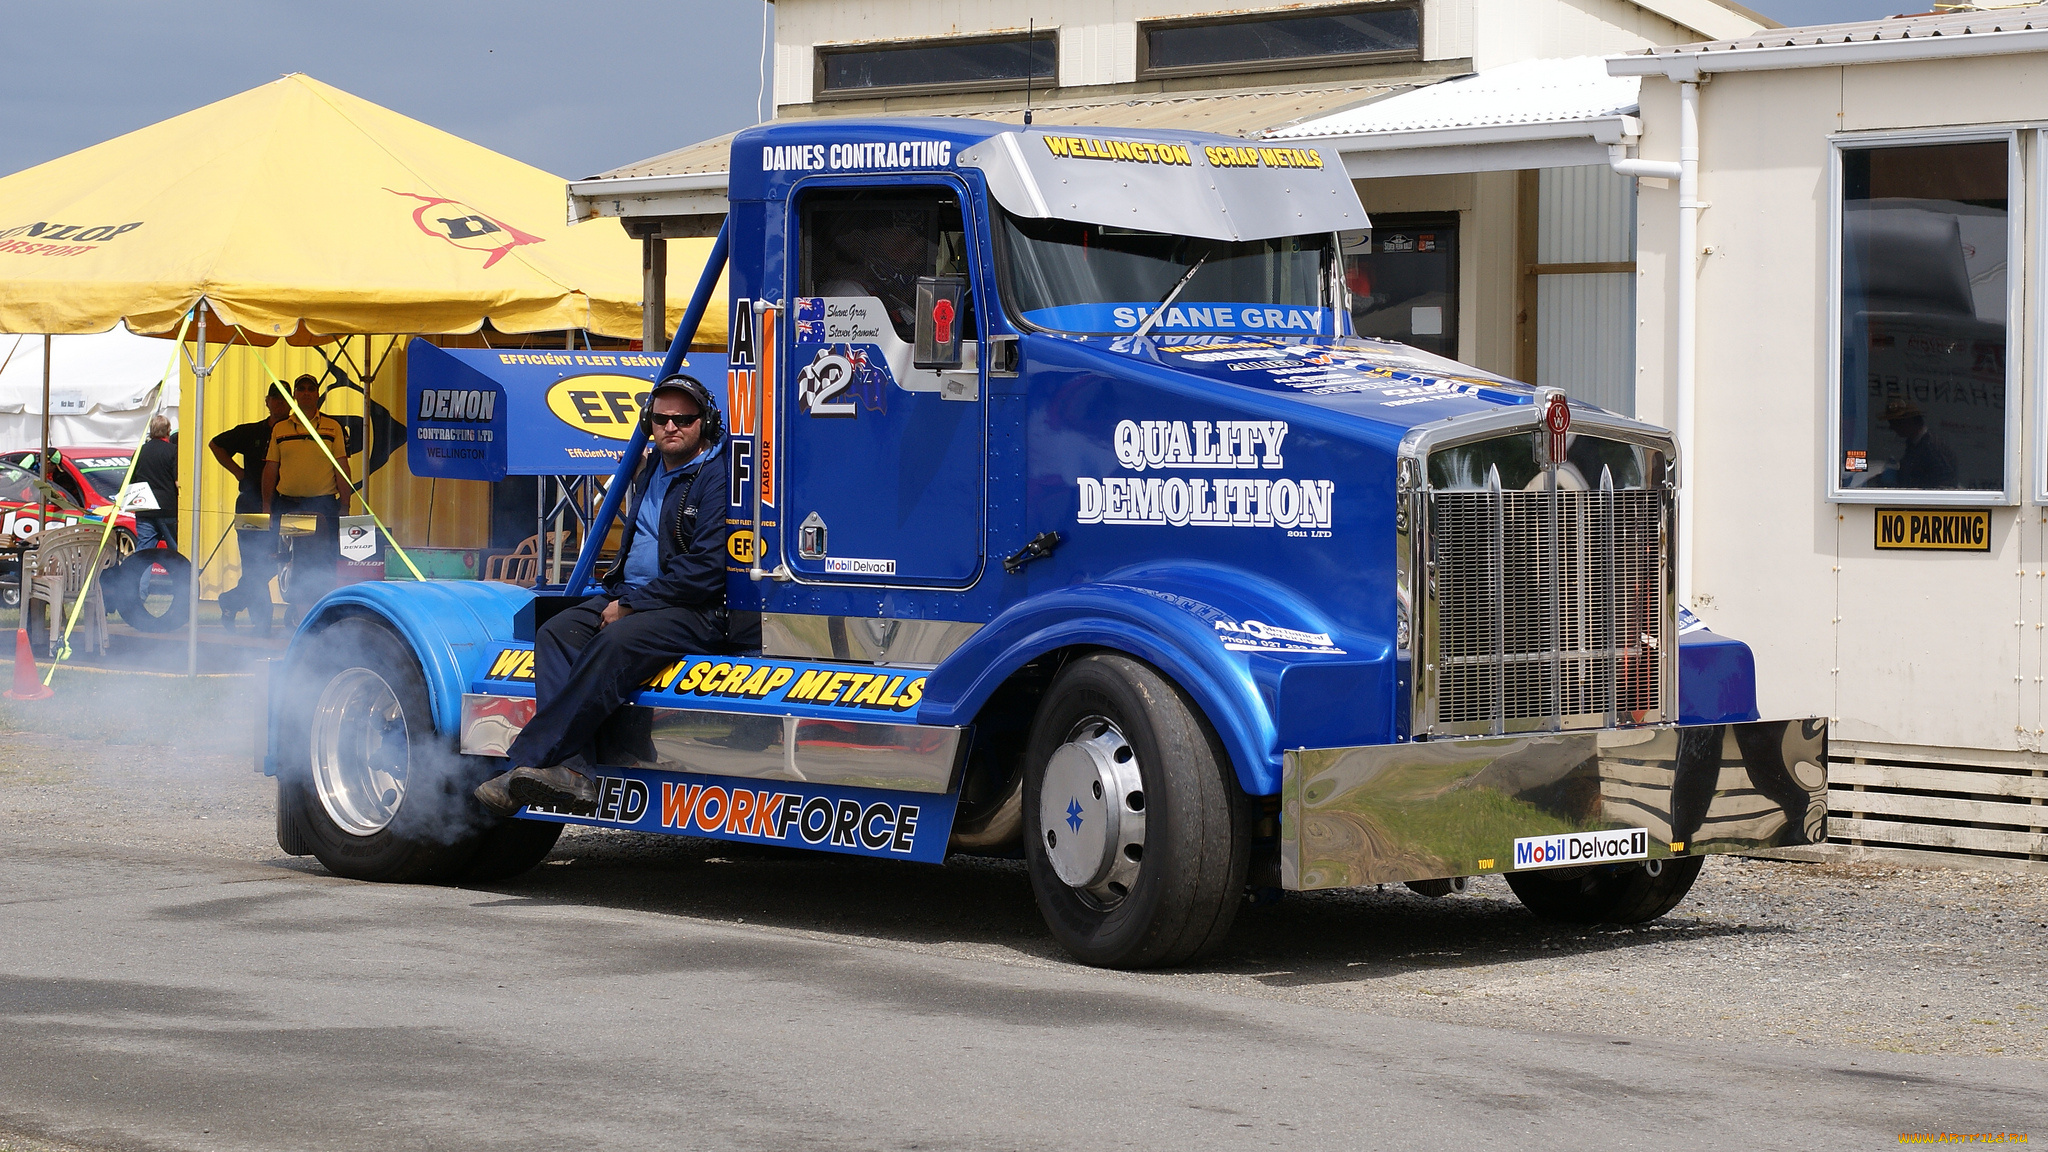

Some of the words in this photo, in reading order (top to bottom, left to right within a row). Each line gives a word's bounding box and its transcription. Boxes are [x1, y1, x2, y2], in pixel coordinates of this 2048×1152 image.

[762, 144, 825, 171] DAINES
[829, 140, 952, 169] CONTRACTING
[1043, 135, 1192, 166] WELLINGTON
[1204, 145, 1260, 167] SCRAP
[1258, 147, 1324, 169] METALS
[827, 304, 848, 318] Shane
[849, 304, 867, 321] Gray
[1113, 307, 1236, 329] SHANE
[1240, 308, 1322, 330] GRAY
[851, 324, 880, 341] Zammit
[499, 353, 573, 367] EFFICIENT
[576, 354, 618, 368] FLEET
[808, 354, 858, 420] 2
[418, 389, 497, 423] DEMON
[417, 427, 475, 441] CONTRACTING
[477, 429, 494, 443] LTD
[1114, 419, 1288, 472] QUALITY
[426, 447, 485, 460] WELLINGTON
[762, 440, 771, 495] LABOUR
[1076, 477, 1334, 528] DEMOLITION
[1287, 530, 1308, 538] 2011
[1311, 530, 1332, 538] LTD
[1882, 515, 1905, 543] NO
[1910, 515, 1984, 545] PARKING
[827, 559, 852, 571] Mobil
[853, 560, 886, 573] Delvac
[1219, 635, 1257, 645] Phone
[1261, 640, 1281, 648] 027
[674, 661, 794, 700] SCRAP
[785, 669, 926, 712] METALS
[662, 781, 920, 853] WORKFORCE
[1517, 839, 1565, 864] Mobil
[1569, 836, 1629, 860] Delvac
[1631, 832, 1645, 854] 1
[1669, 841, 1685, 852] TOW
[1478, 858, 1495, 870] TOW
